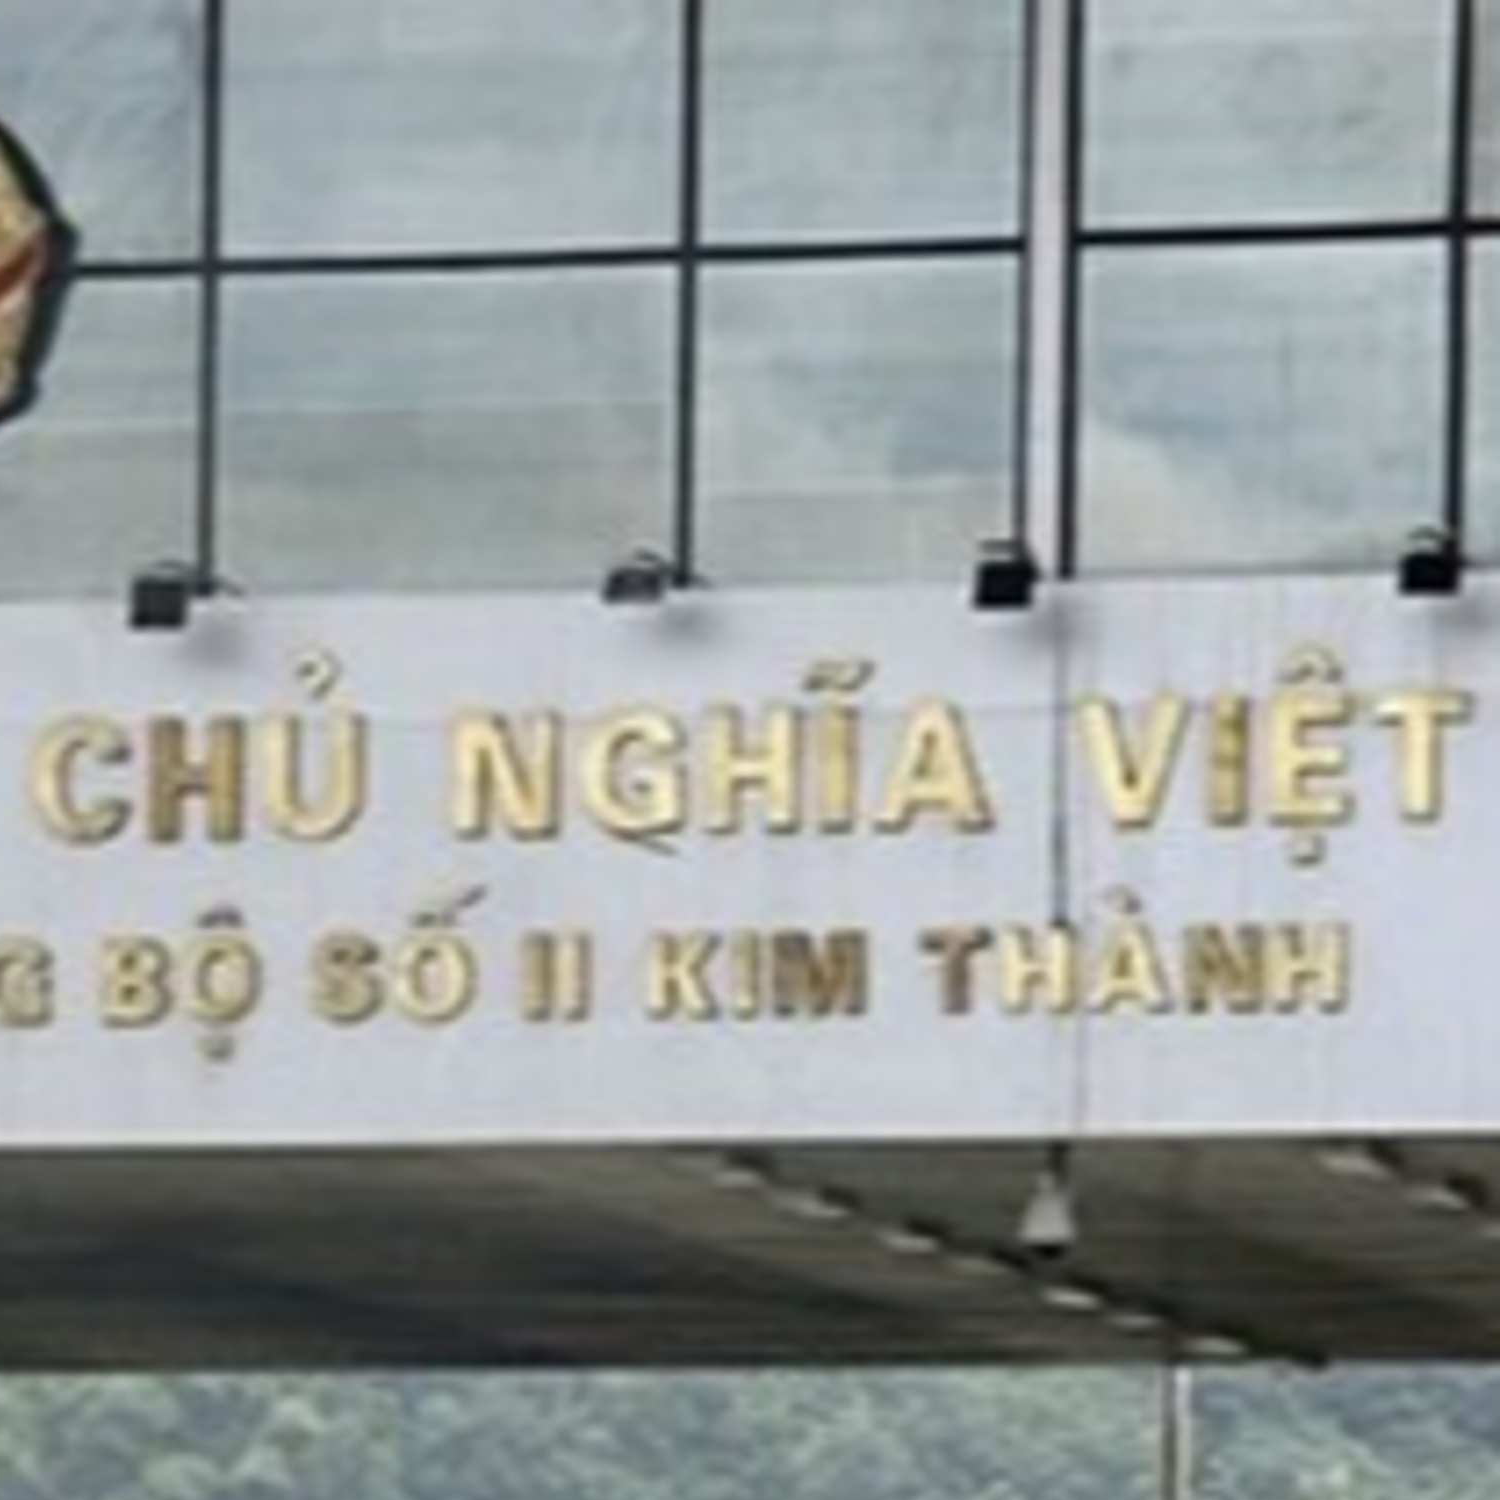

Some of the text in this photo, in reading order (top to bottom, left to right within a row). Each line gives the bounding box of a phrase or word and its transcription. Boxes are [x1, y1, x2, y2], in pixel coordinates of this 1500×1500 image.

[28, 650, 370, 846] CHỦ
[447, 658, 996, 855] NGHĨA
[1078, 645, 1475, 866] VIỆT
[100, 905, 264, 1062] BỘ
[308, 884, 488, 1025] SỐ
[645, 924, 870, 1022] KIM
[920, 884, 1352, 1016] THÀNH
